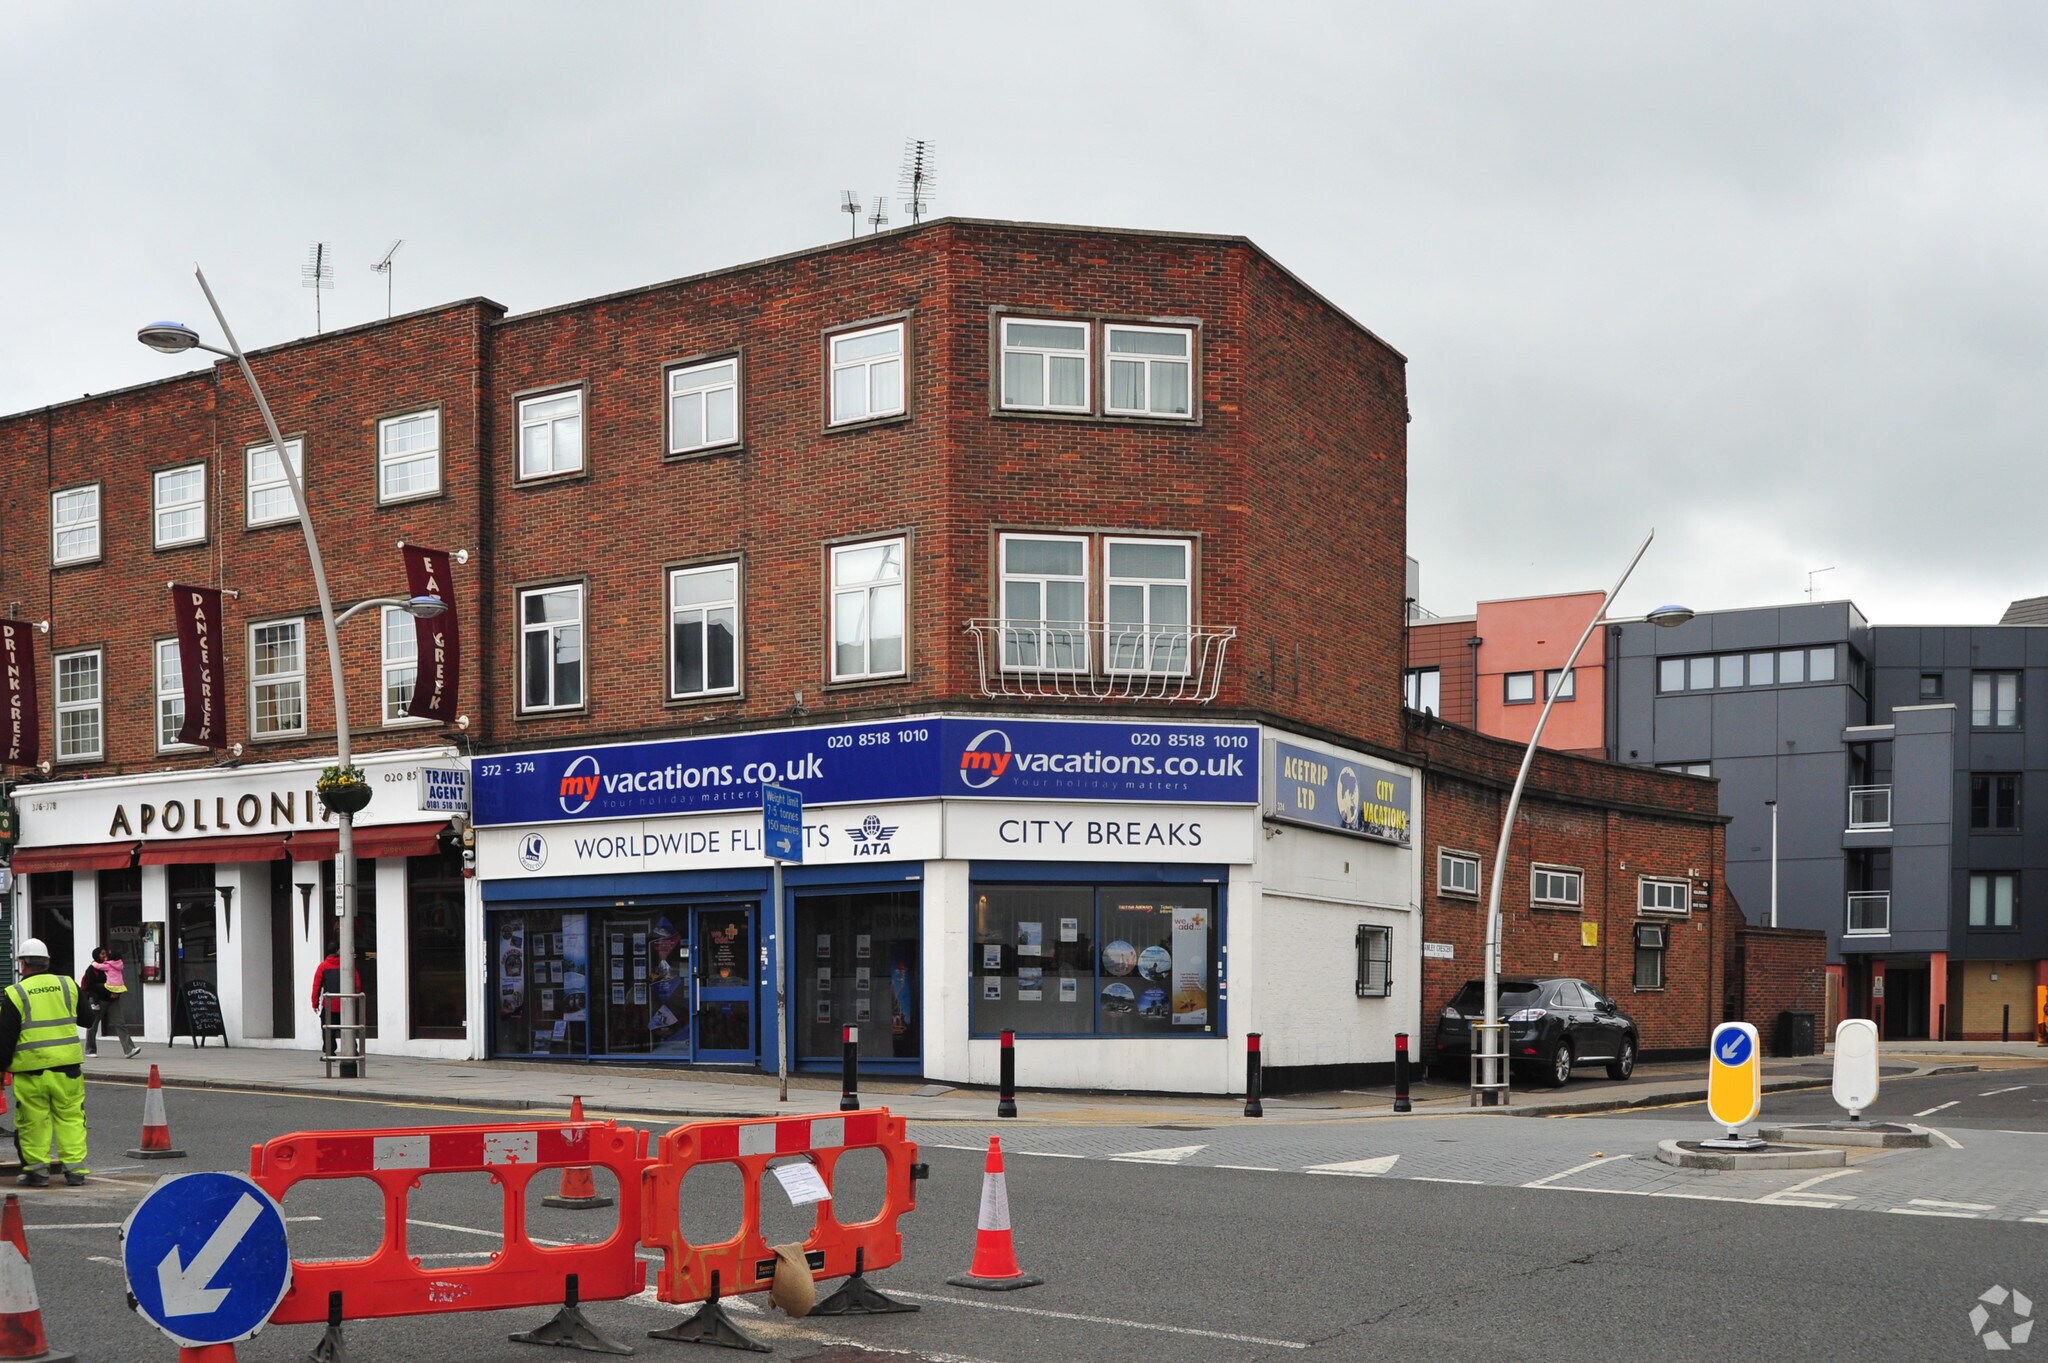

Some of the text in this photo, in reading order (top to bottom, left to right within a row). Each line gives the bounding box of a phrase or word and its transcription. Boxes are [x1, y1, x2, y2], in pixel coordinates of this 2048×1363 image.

[191, 592, 209, 664] DANCE
[3, 625, 21, 690] DRINK
[429, 632, 446, 710] GREEK
[199, 667, 212, 740] GREEK
[8, 694, 22, 760] GREEK
[826, 728, 929, 749] 020 8518 1010
[1130, 732, 1249, 749] 020 8518 1010
[384, 770, 418, 782] 020 85
[425, 769, 466, 786] TRAVEL
[481, 764, 502, 777] 372
[515, 761, 536, 774] 374
[1284, 755, 1329, 787] ACETRIP
[1055, 777, 1118, 790] holiday
[1125, 781, 1188, 790] matters
[1376, 779, 1395, 803] CITY
[429, 785, 464, 801] AGENT
[701, 790, 760, 803] matters
[766, 790, 799, 808] Weight limit
[1297, 786, 1316, 811] LTD
[426, 800, 468, 810] 0181 518 1010
[779, 807, 799, 822] tonnes
[1363, 801, 1407, 831] VACATIONS
[767, 818, 800, 836] 150 metres
[998, 819, 1202, 847] CITY BREAKS
[574, 824, 830, 860] WORLDWIDE FLITS
[853, 842, 891, 856] IATA
[27, 985, 62, 996] KENSON
